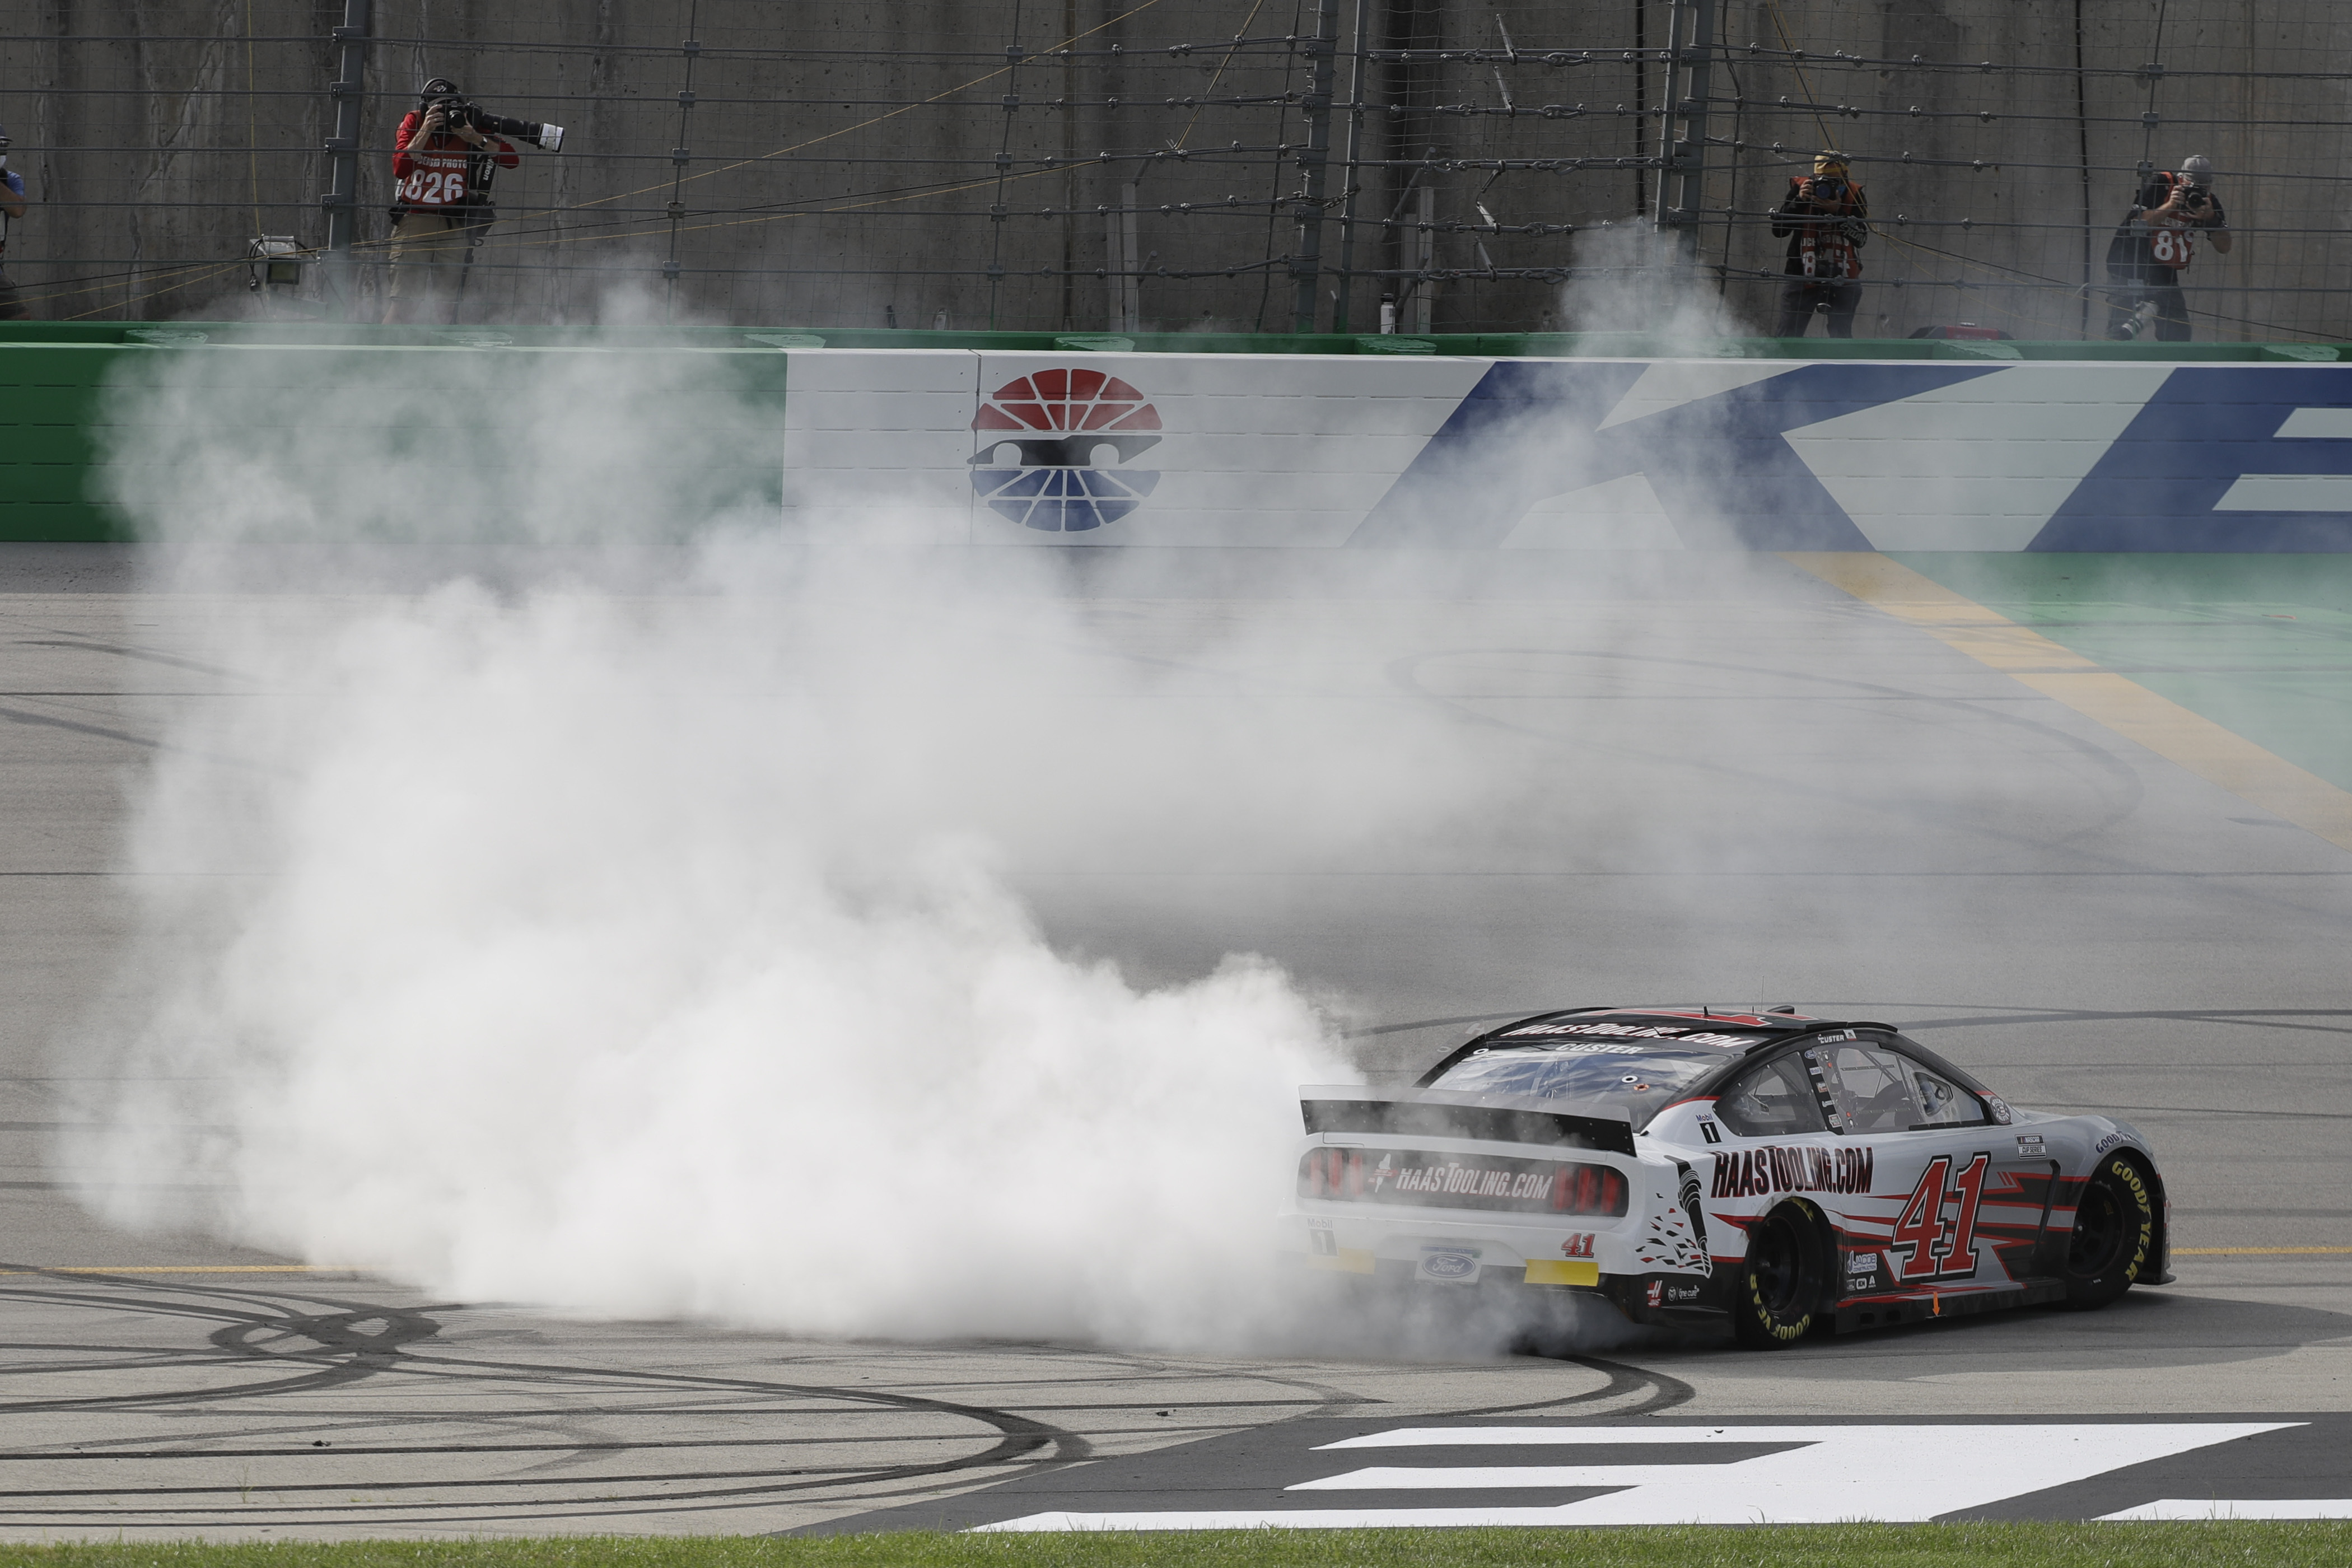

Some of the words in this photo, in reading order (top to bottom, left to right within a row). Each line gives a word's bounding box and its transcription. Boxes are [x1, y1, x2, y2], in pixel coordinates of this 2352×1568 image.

[405, 169, 464, 203] 826
[1555, 1043, 1644, 1054] CUSTER
[1696, 1113, 1714, 1122] Mobil
[1705, 1123, 1716, 1142] 1
[1396, 1162, 1553, 1199] HAASTOOLING.COM
[1707, 1145, 1874, 1198] HAASTOOLING.COM
[1307, 1217, 1333, 1229] Mobil
[1891, 1151, 1991, 1285] 41
[2112, 1161, 2152, 1281] GOODYEAR
[1317, 1231, 1328, 1254] 1
[1561, 1233, 1595, 1258] 41
[1432, 1257, 1465, 1272] Ford
